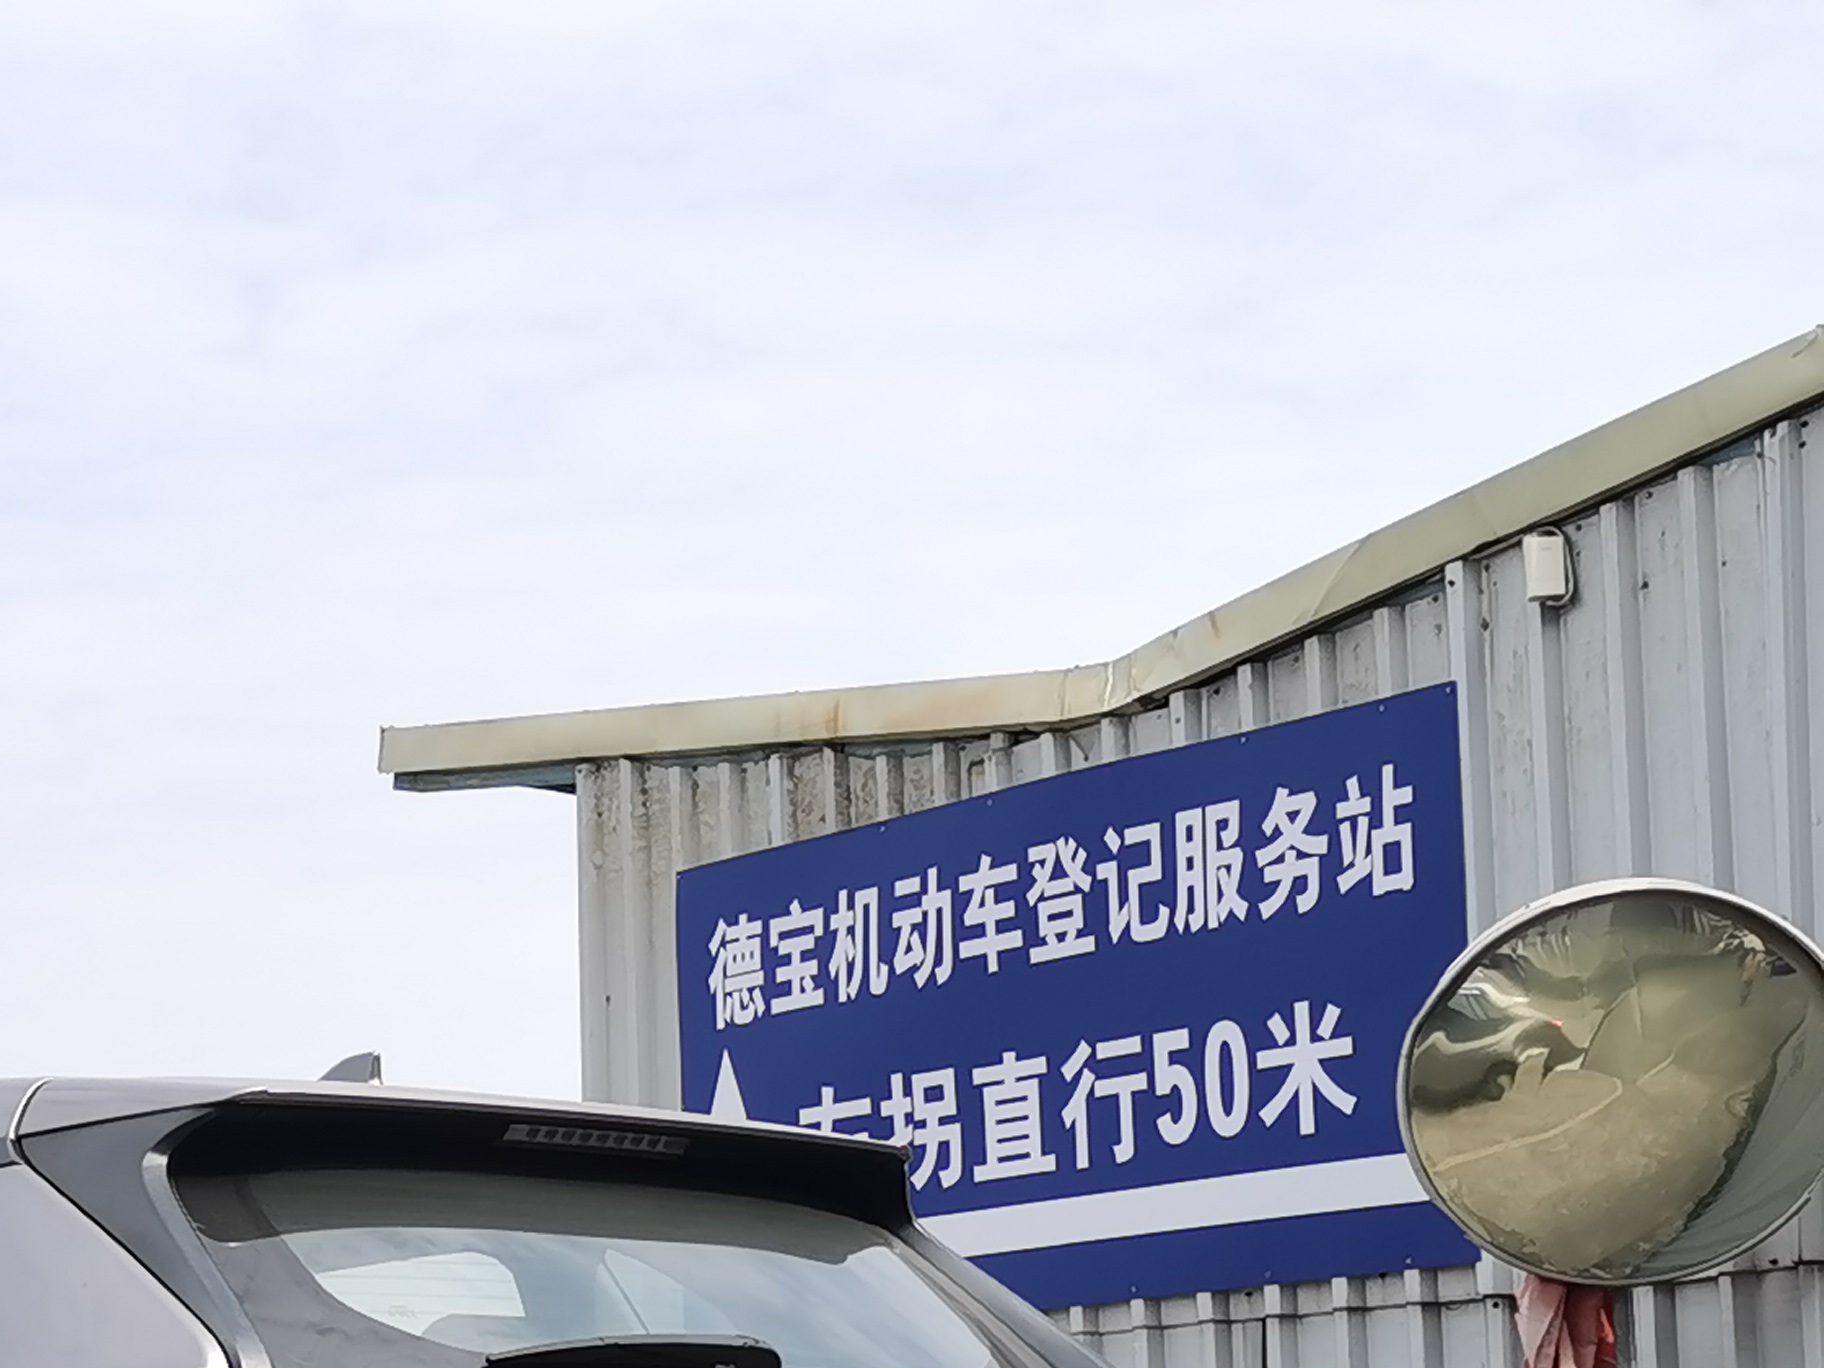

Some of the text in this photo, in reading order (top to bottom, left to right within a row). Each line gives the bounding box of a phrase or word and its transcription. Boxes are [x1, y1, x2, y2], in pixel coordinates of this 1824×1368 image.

[707, 763, 1415, 1030] 德宝机动车登记服务站
